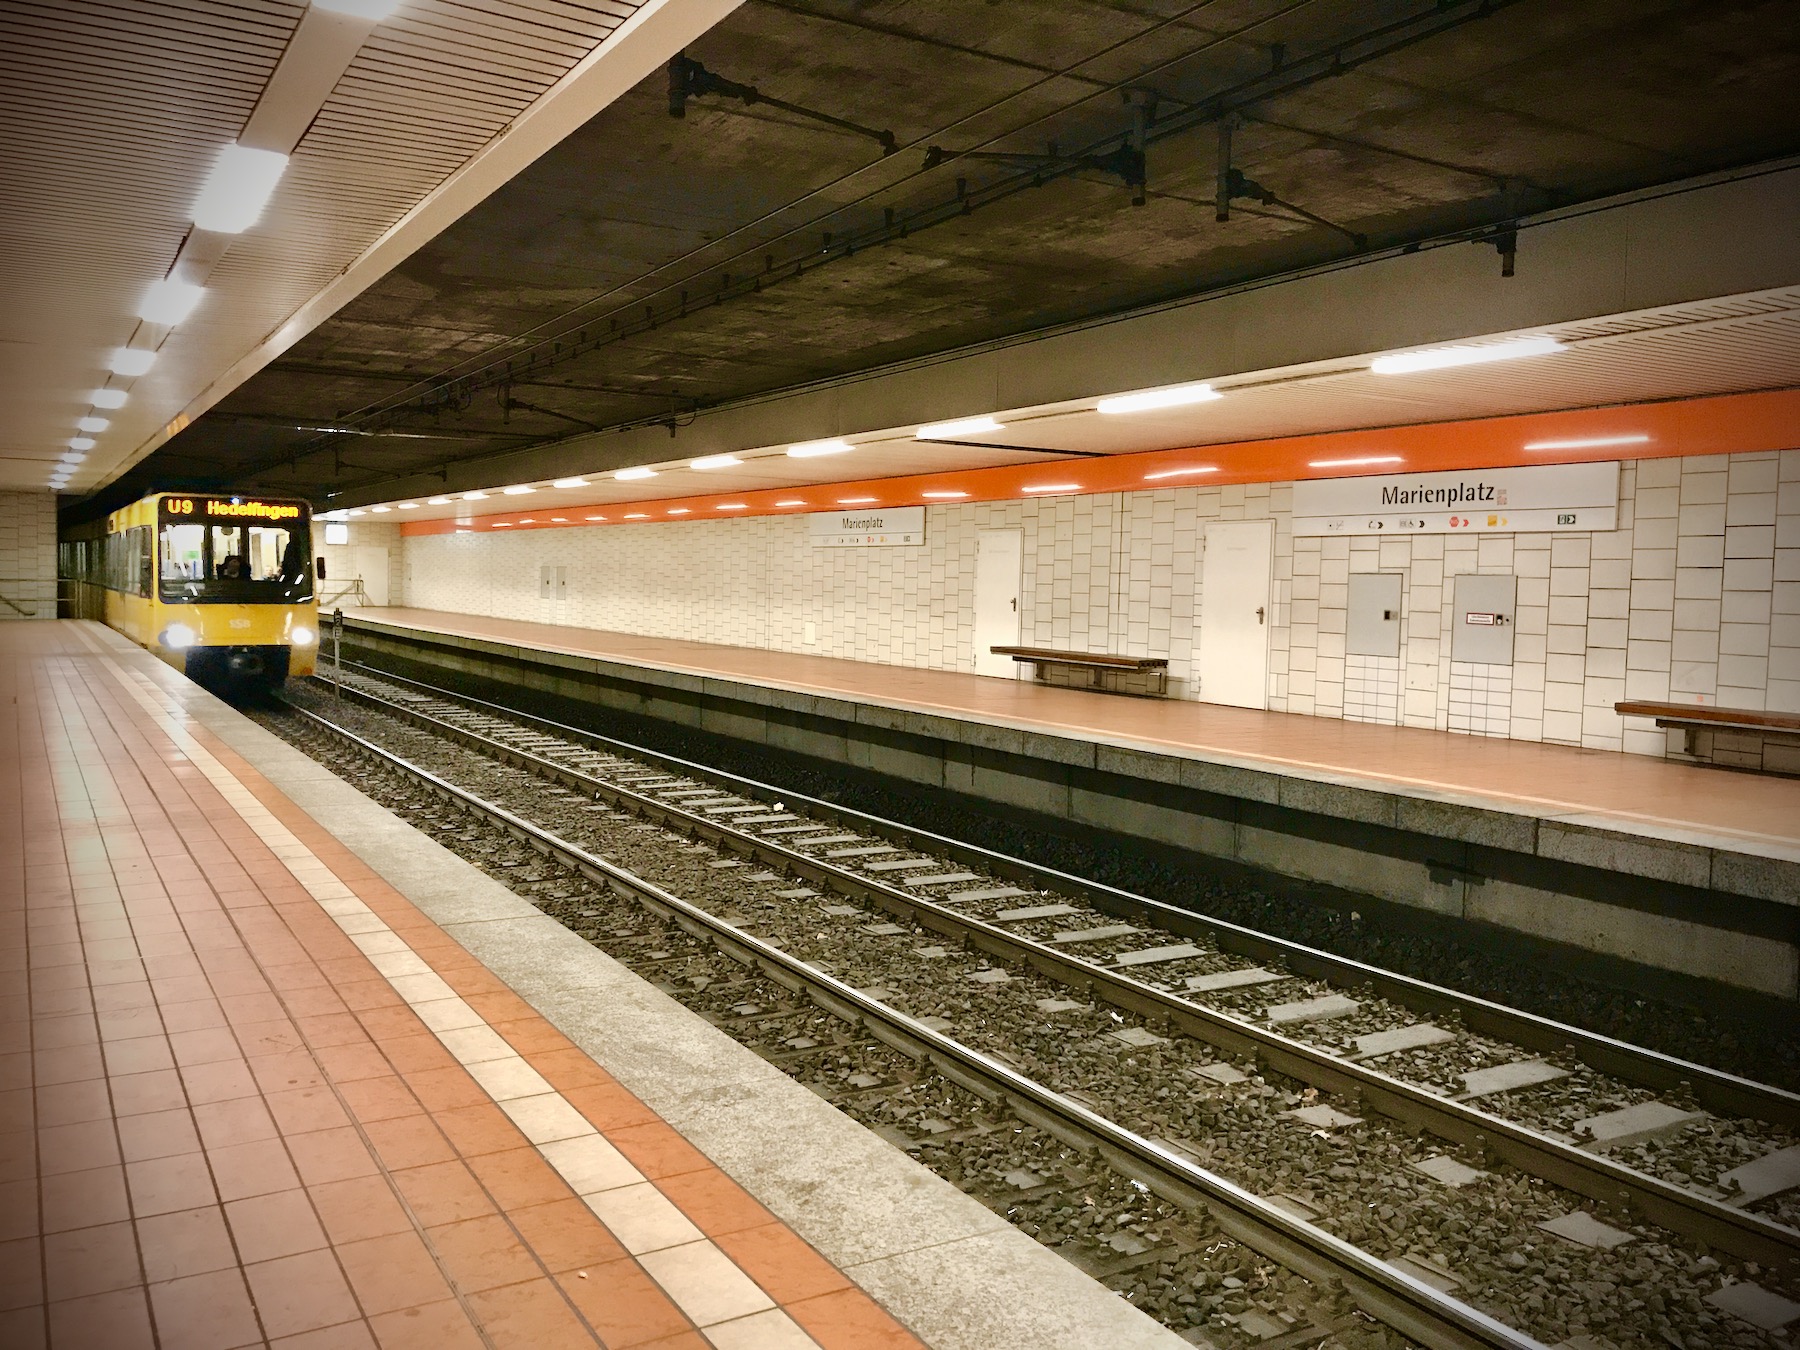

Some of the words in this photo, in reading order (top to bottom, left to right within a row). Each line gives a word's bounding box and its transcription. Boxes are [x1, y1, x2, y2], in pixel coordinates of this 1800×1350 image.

[1382, 482, 1495, 507] Marienplatz
[167, 498, 193, 514] U9
[207, 500, 299, 519] Hedelfingen
[842, 517, 883, 531] Marienplatz
